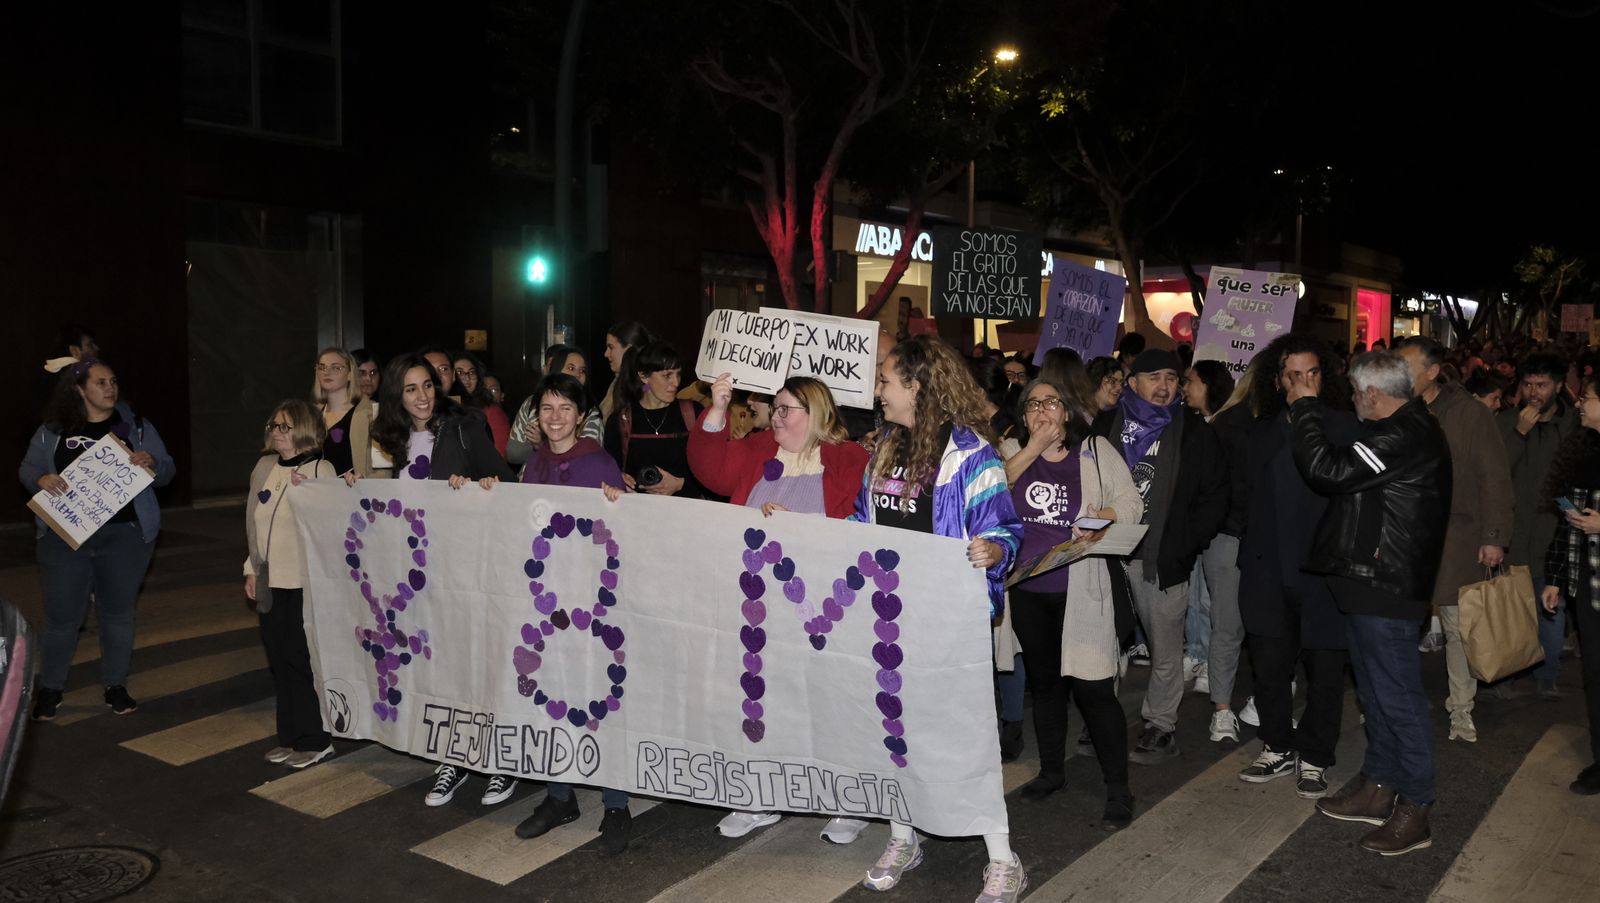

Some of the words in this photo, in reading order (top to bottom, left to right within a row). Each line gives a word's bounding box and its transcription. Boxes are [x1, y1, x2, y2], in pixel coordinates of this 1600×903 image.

[856, 223, 934, 262] ABAC
[960, 230, 1018, 255] SOMOS
[952, 252, 969, 273] EL
[973, 253, 1018, 275] GRITO
[1000, 276, 1030, 297] QUE
[1062, 268, 1094, 293] SOMOS
[1099, 279, 1112, 300] EL
[1217, 276, 1252, 295] que
[1261, 283, 1291, 297] ser
[942, 293, 963, 313] YA
[715, 310, 733, 334] MI
[736, 312, 790, 341] CUERPO
[794, 323, 819, 347] EX
[825, 329, 870, 355] WORK
[705, 338, 718, 361] MI
[719, 340, 783, 373] DECISIÓN
[1231, 340, 1255, 351] una
[790, 352, 802, 370] S
[808, 354, 861, 380] WORK
[64, 468, 76, 483] de
[95, 445, 138, 486] SOMOS
[93, 471, 130, 505] NIETAS
